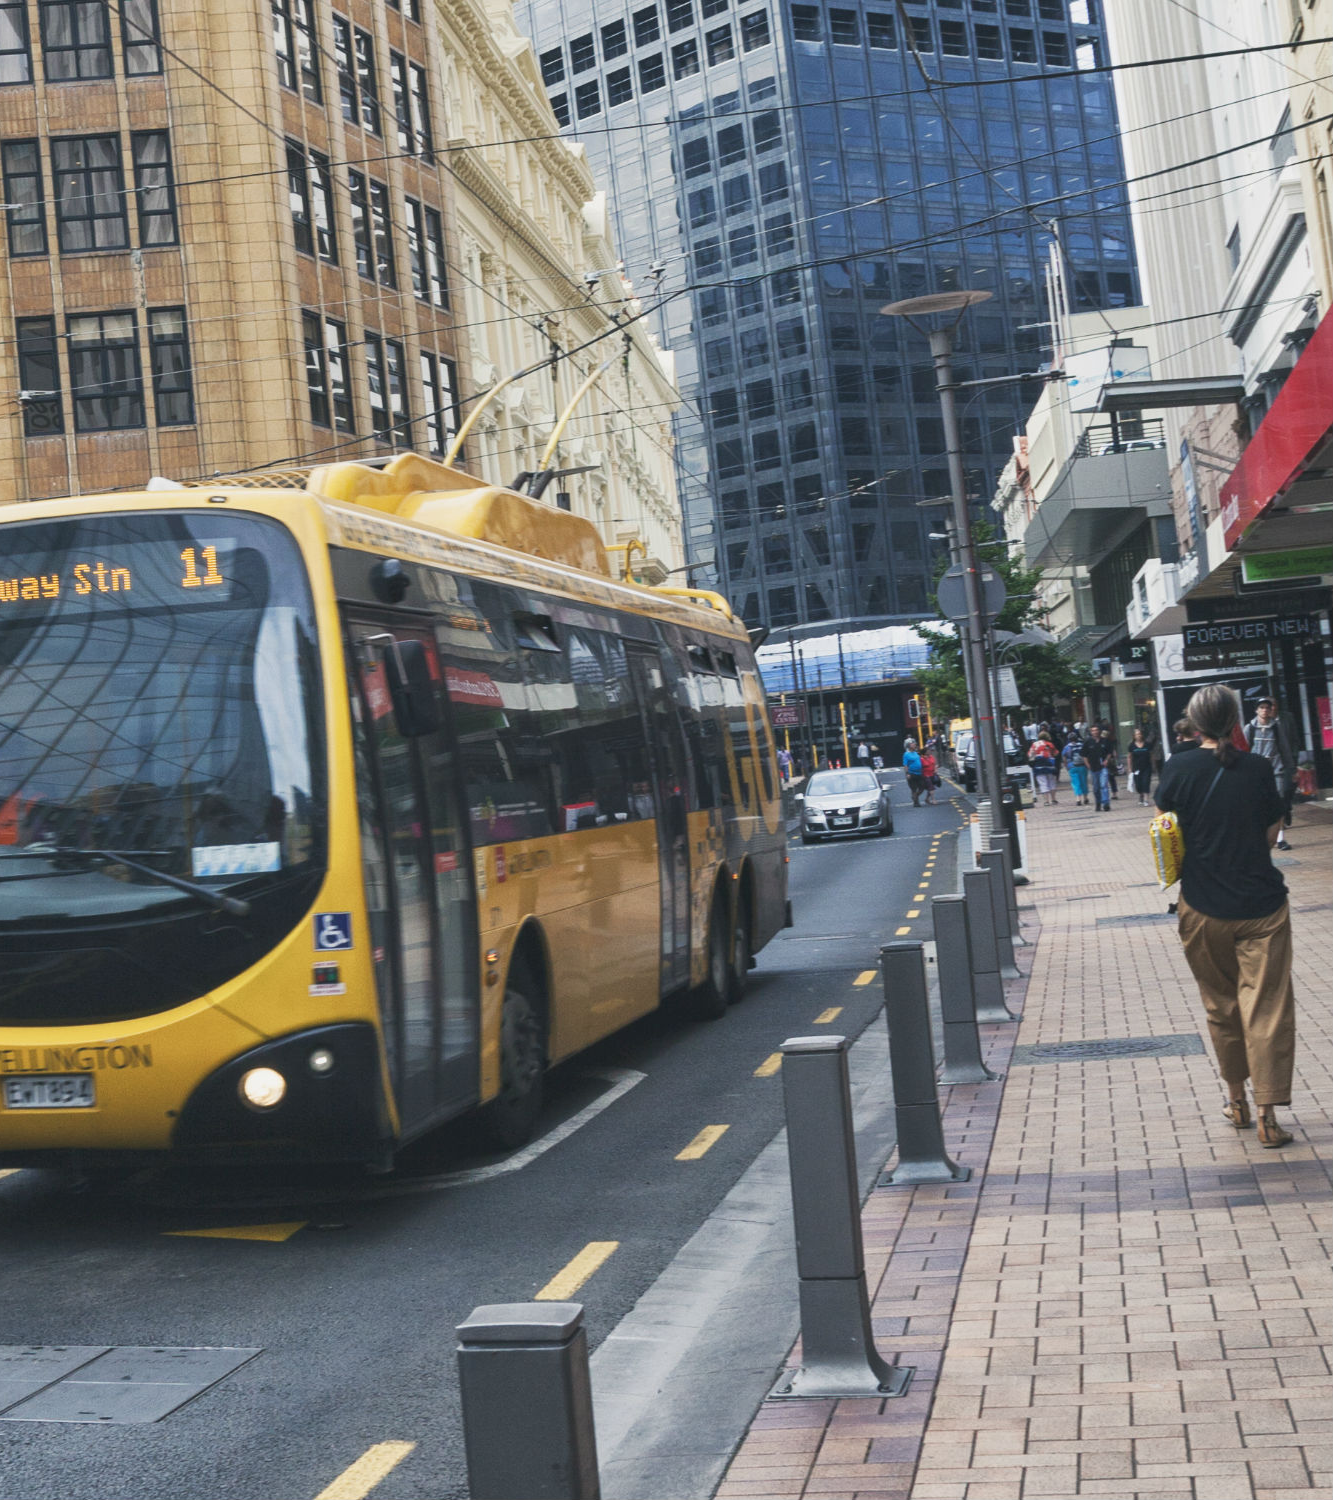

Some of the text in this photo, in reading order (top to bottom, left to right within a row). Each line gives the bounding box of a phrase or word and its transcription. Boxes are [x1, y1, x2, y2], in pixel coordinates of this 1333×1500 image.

[73, 562, 132, 595] Stn
[179, 545, 224, 588] 11
[1186, 618, 1309, 645] FOREVER NEW
